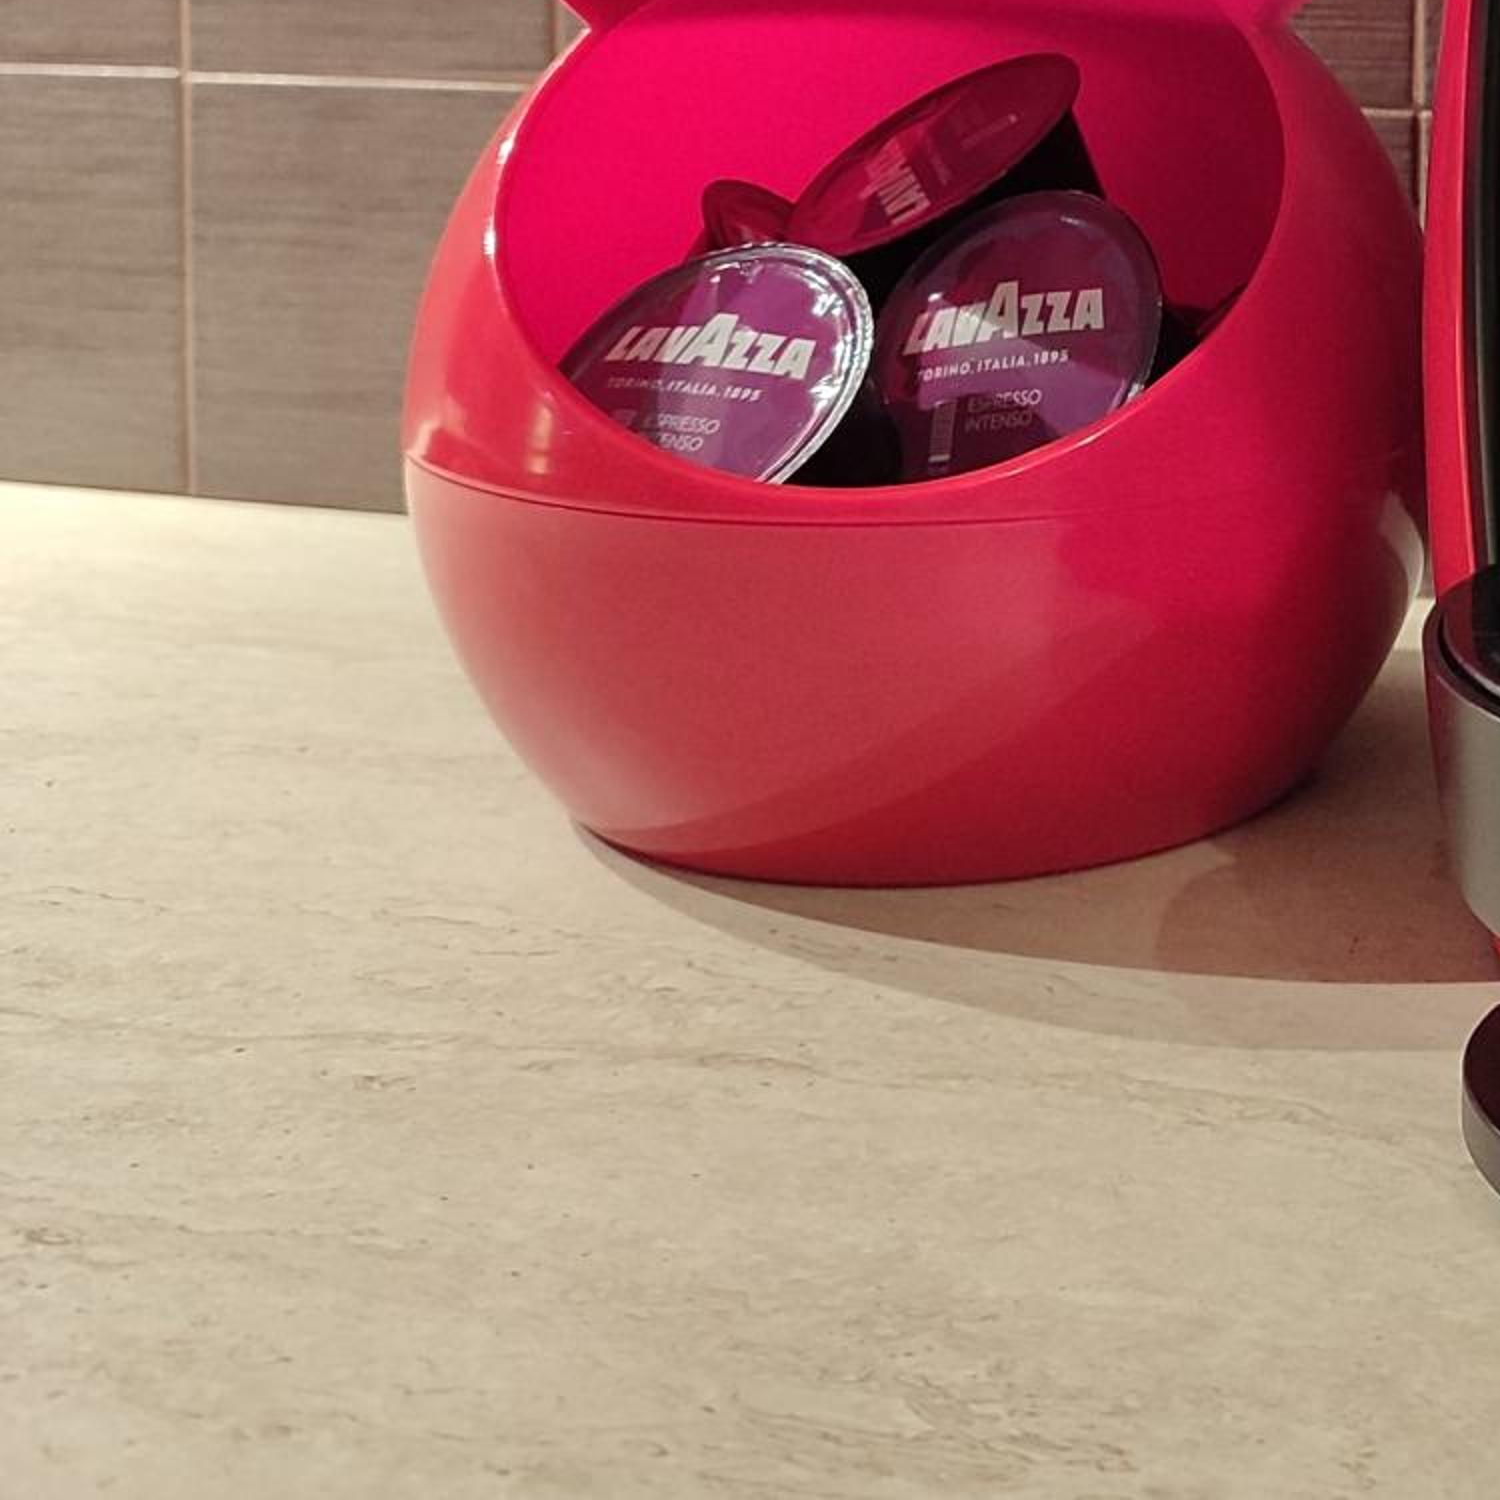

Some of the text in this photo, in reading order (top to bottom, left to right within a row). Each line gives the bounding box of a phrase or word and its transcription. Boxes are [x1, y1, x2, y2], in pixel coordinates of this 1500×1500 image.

[903, 281, 1105, 356] LAVAZZA
[605, 312, 817, 380] LAVAZZA
[1034, 349, 1069, 367] 1895
[722, 385, 763, 402] 1895
